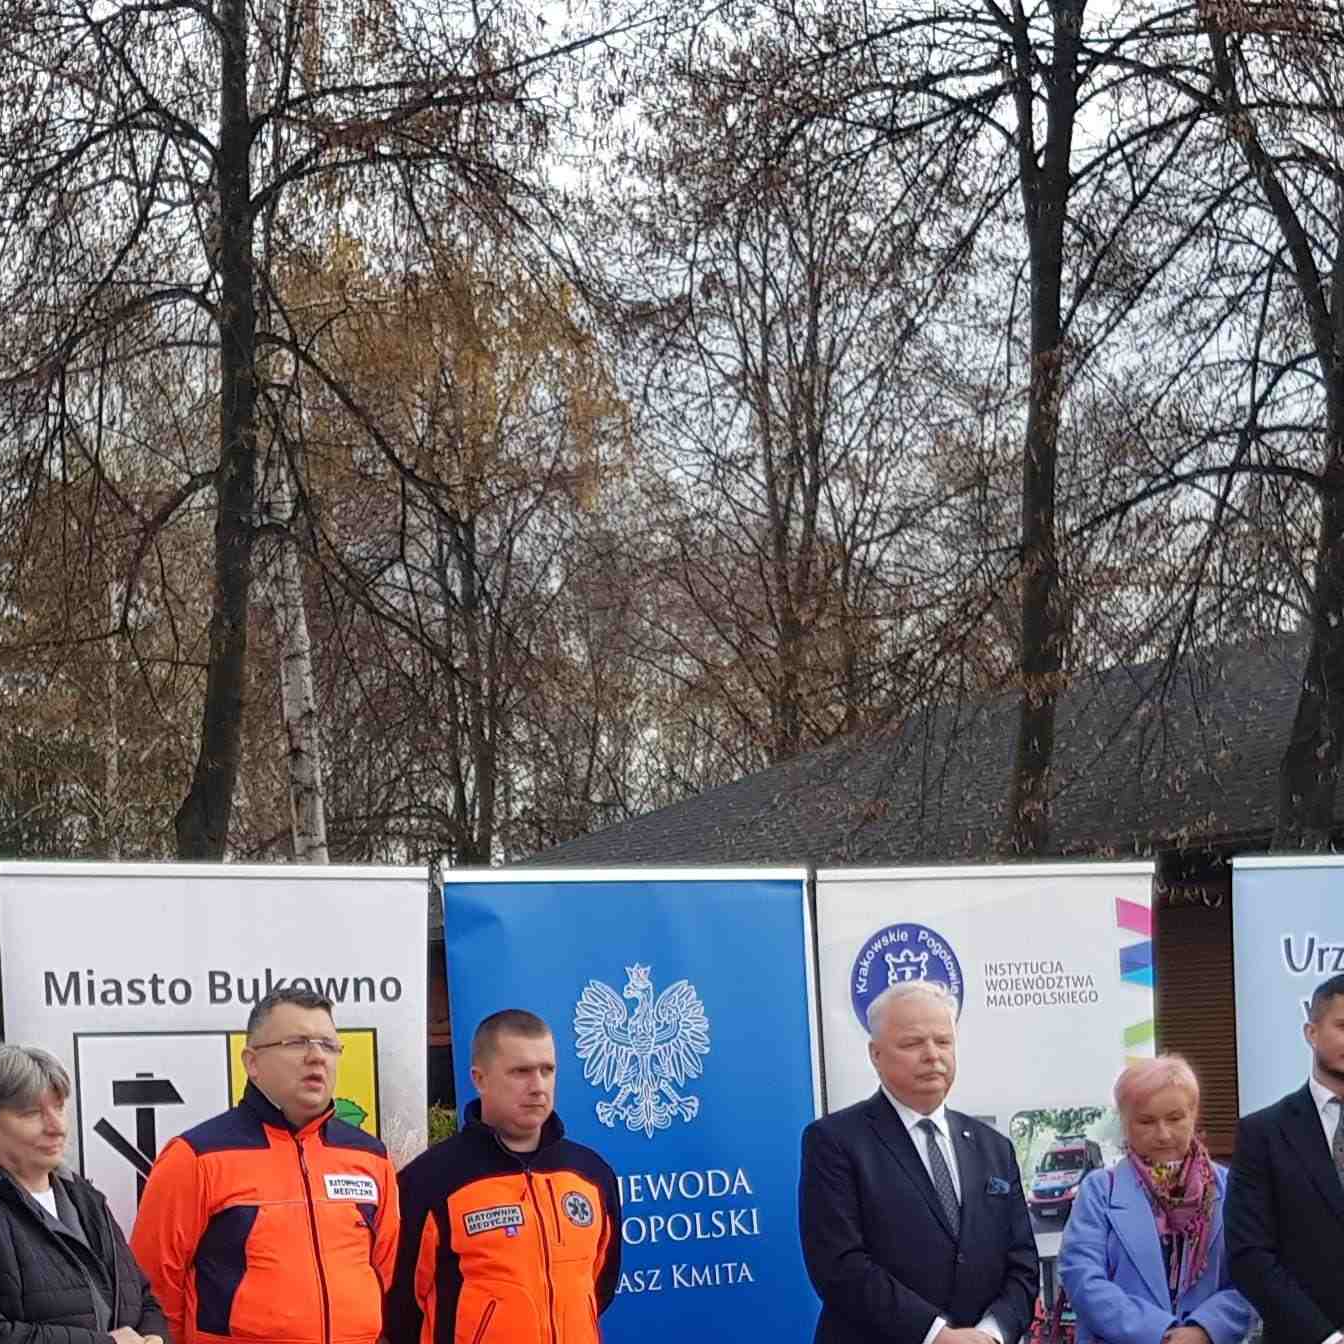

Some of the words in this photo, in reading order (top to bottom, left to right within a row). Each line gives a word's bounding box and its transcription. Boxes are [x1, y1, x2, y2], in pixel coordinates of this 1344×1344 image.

[856, 928, 909, 994] Krakowskie
[984, 960, 1064, 977] INSTYTUCJA
[43, 969, 193, 1006] Miasto
[985, 974, 1094, 992] WOJEWÓDZTWA
[986, 990, 1099, 1008] MAŁOPOLSKIEGO
[622, 1208, 760, 1245] OPOLSKI
[615, 1269, 662, 1294] ASZ
[672, 1262, 755, 1289] KMITA
